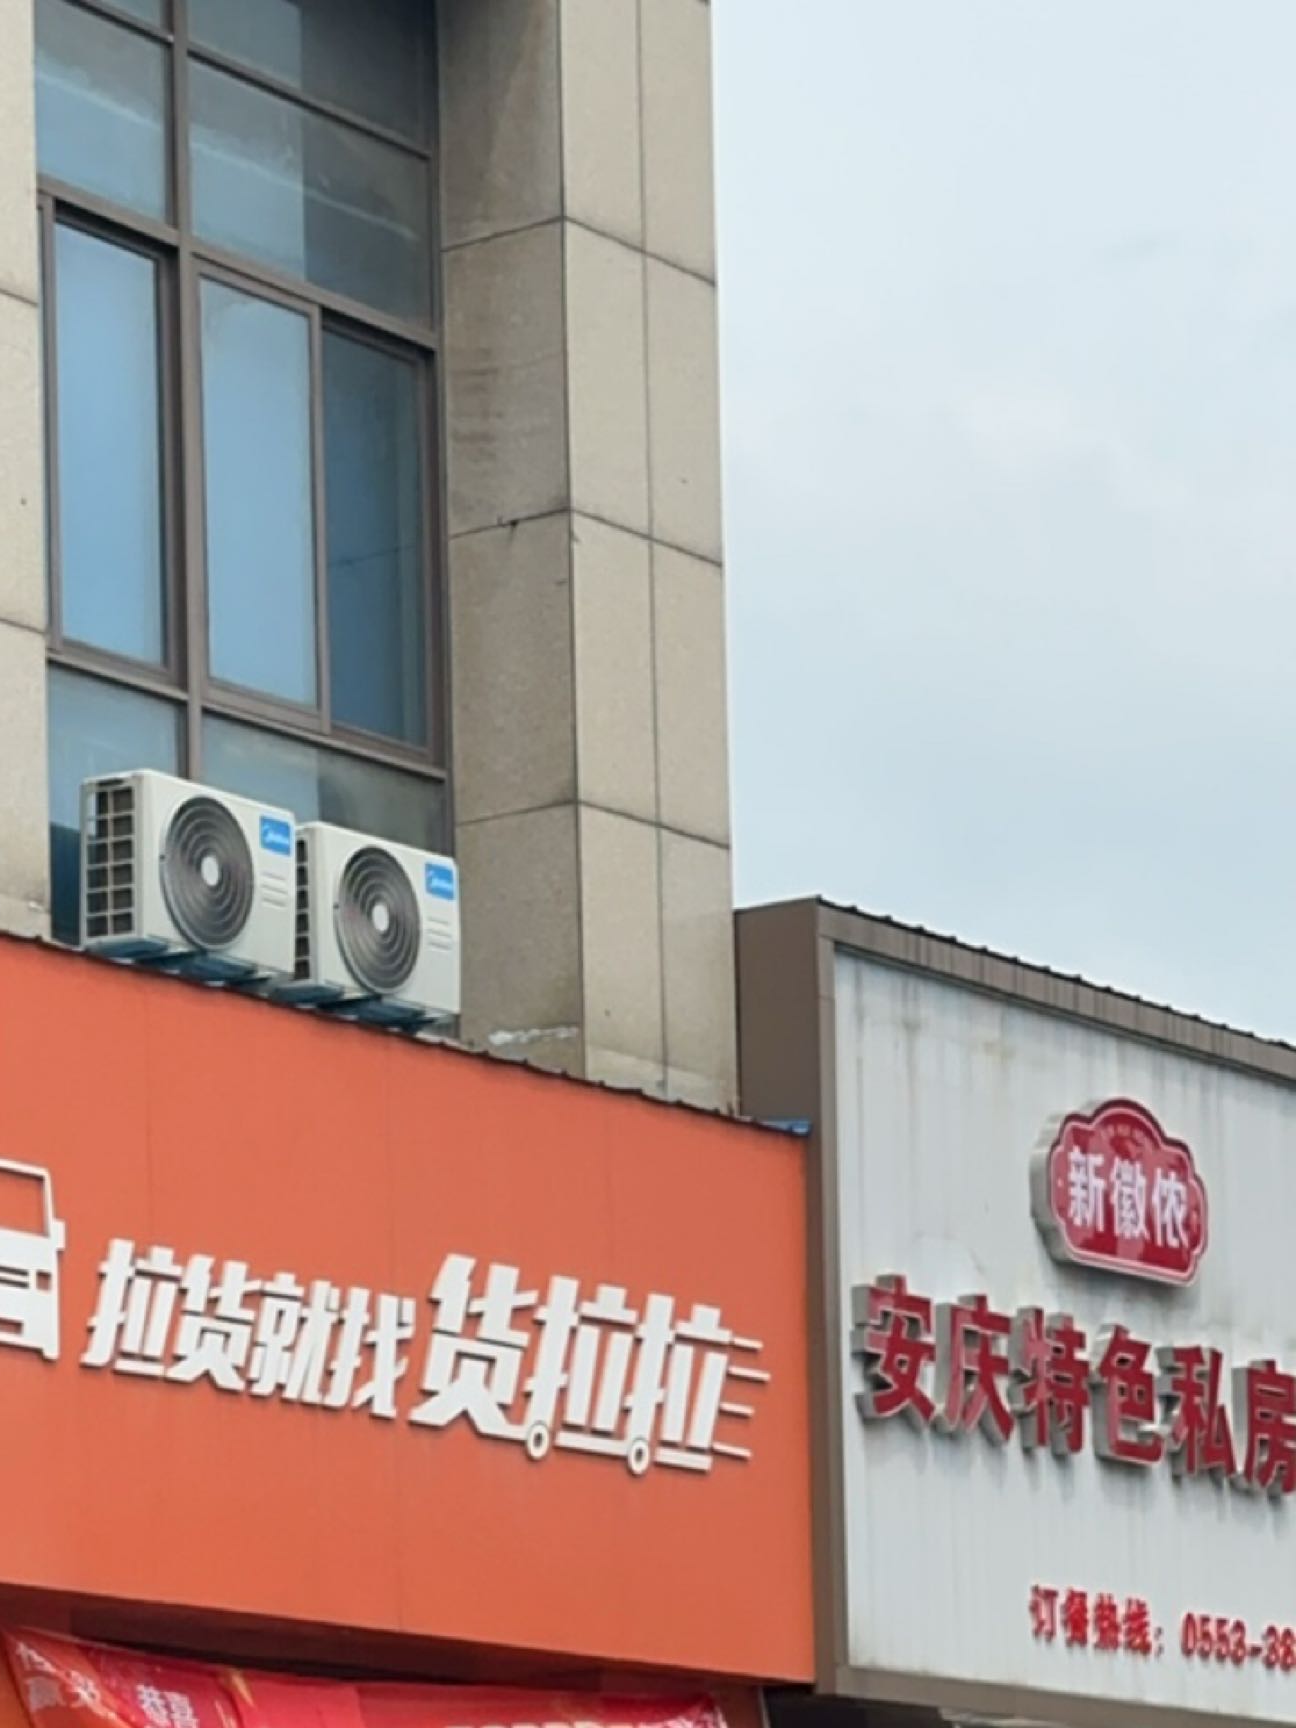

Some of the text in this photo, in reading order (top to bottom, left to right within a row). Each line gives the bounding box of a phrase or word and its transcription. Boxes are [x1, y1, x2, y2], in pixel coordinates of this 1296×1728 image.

[852, 1274, 1296, 1497] 安庆特色私房
